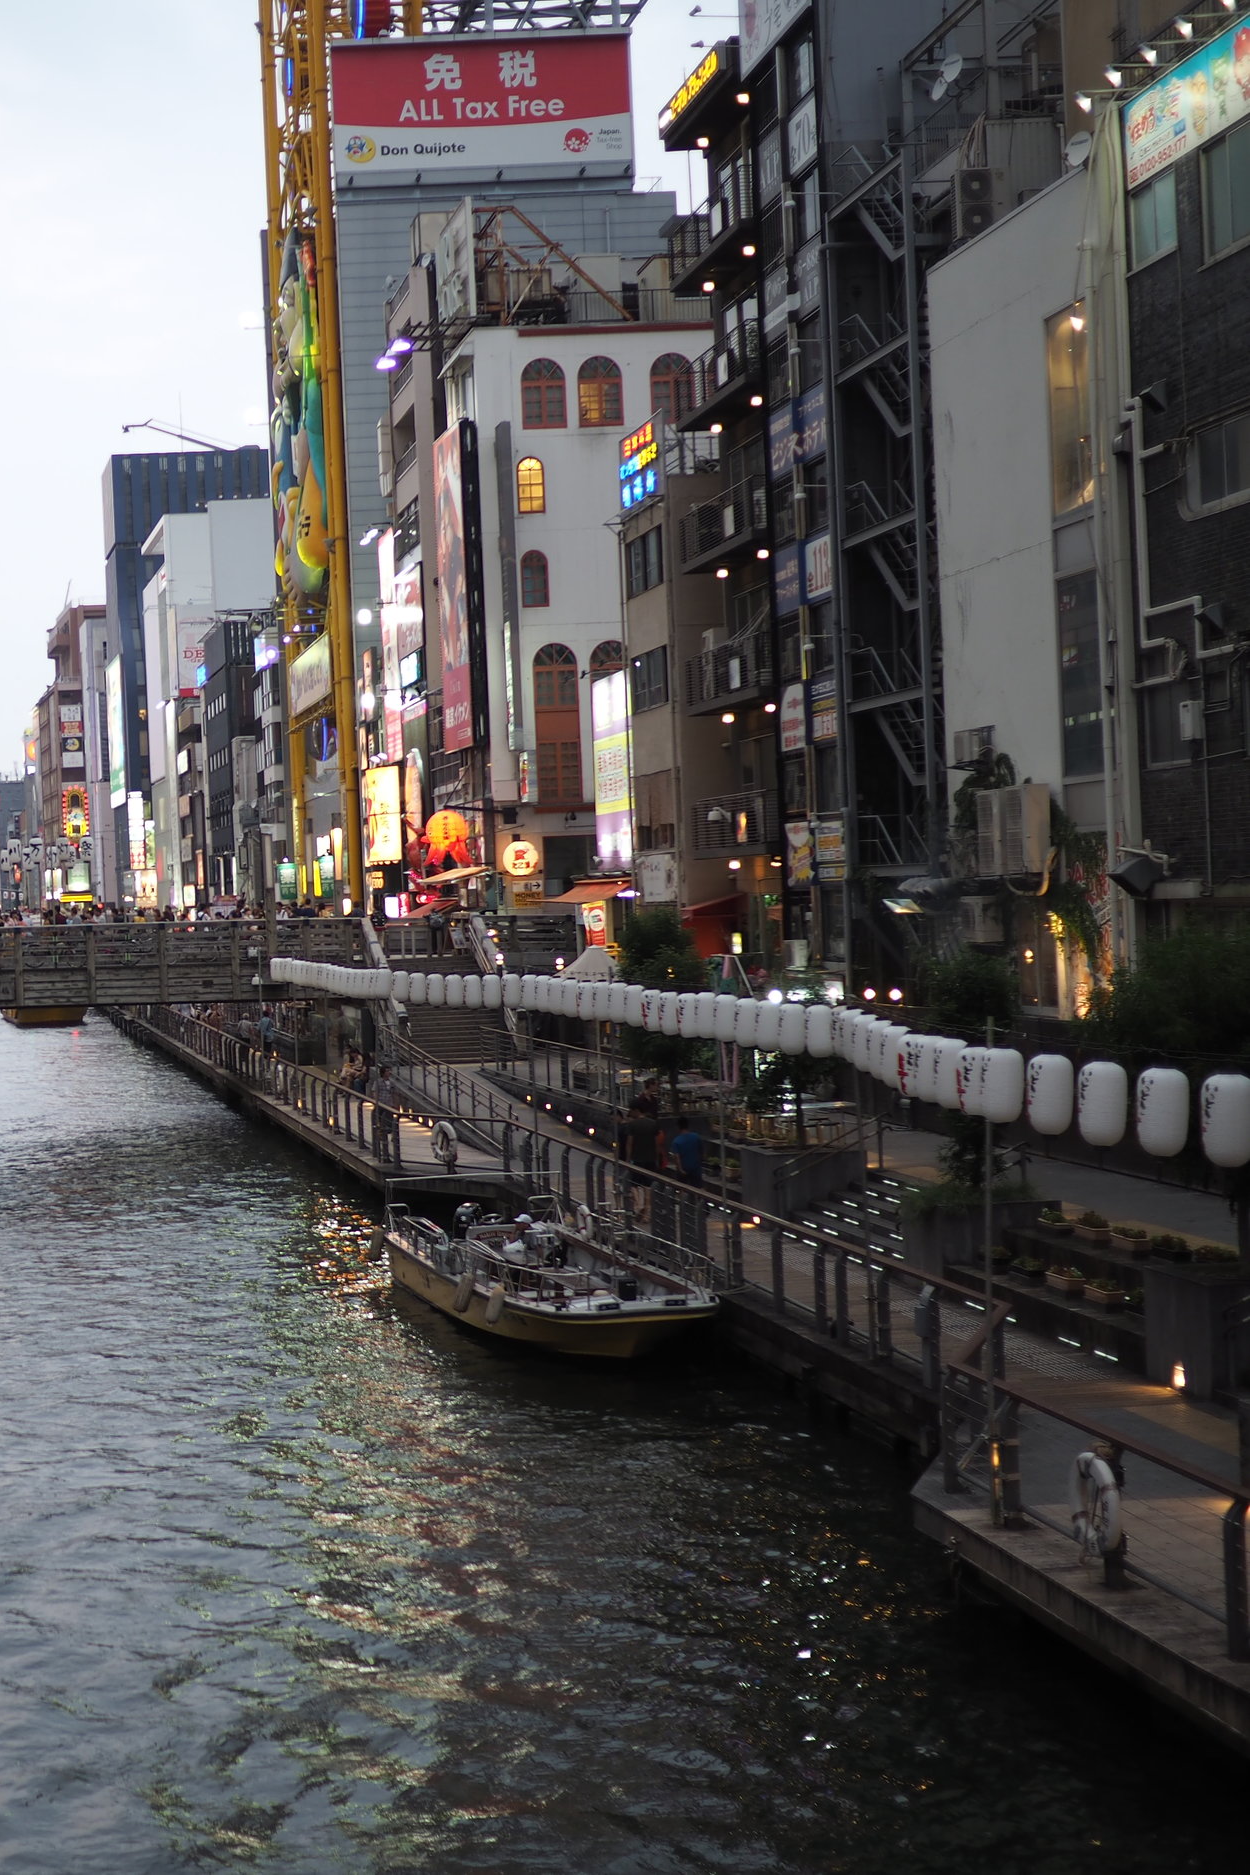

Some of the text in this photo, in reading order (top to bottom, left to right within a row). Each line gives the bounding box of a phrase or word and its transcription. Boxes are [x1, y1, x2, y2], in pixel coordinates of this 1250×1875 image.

[424, 49, 538, 91] 免税
[398, 94, 566, 123] ALL Tax Free
[380, 140, 466, 157] Don Quijote
